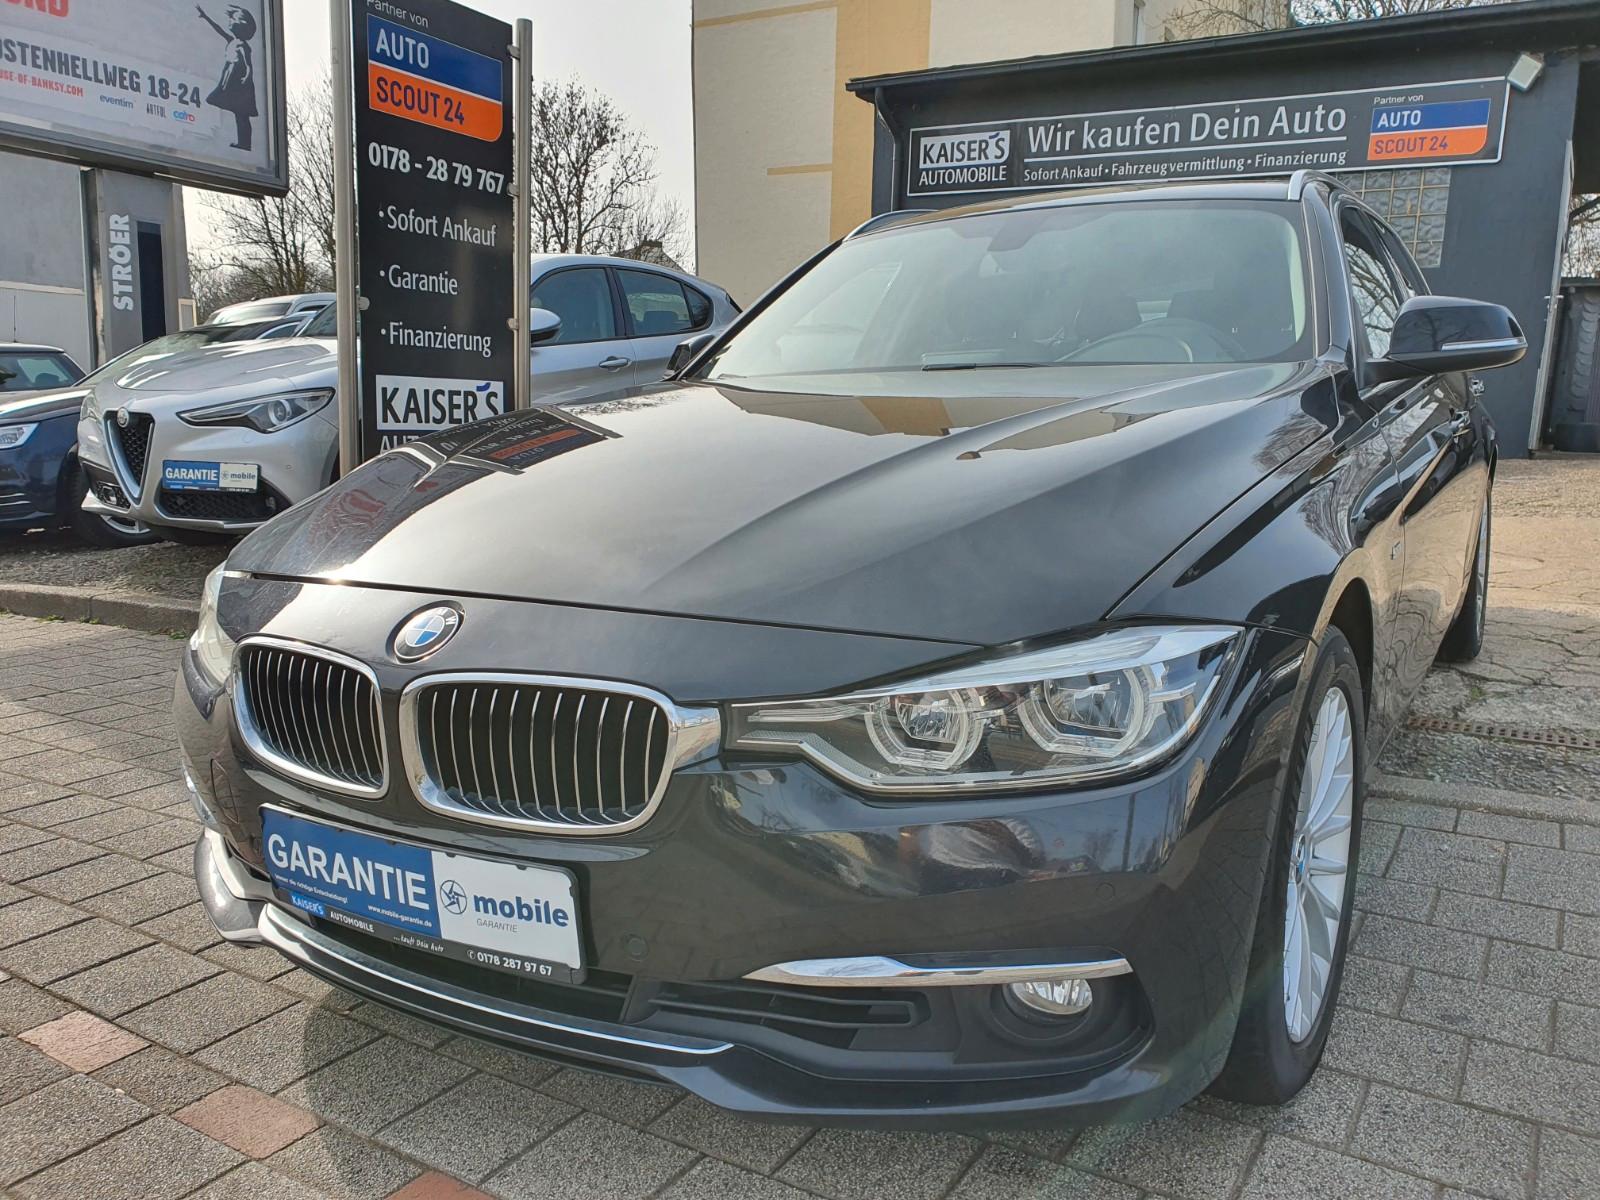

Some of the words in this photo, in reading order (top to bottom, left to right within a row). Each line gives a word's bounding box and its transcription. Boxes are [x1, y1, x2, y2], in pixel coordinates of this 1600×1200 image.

[409, 12, 428, 28] von
[376, 28, 430, 69] AUTO
[0, 38, 141, 94] STENHELLWEG
[147, 74, 201, 108] 18-24
[100, 94, 134, 109] eventim
[1373, 95, 1406, 105] Partner
[1407, 94, 1424, 102] von
[1029, 123, 1076, 153] Wir
[1083, 117, 1180, 150] kaufen
[1190, 108, 1258, 142] Dein
[1268, 104, 1347, 136] Auto
[1377, 110, 1422, 128] AUTO
[368, 142, 410, 173] 0178
[452, 162, 472, 188] 79
[477, 168, 505, 195] 767
[919, 165, 1007, 186] AUTOMOBILE
[1024, 166, 1059, 182] Sofort
[1061, 163, 1102, 180] Ankauf
[1111, 153, 1244, 177] Fahrzeugvermittlung
[1255, 150, 1347, 167] Finanzierung
[387, 205, 438, 238] Sofort
[442, 216, 497, 248] Ankauf
[109, 214, 134, 311] STRÖER
[388, 264, 458, 295] Garantie
[389, 321, 492, 358] Finanzierung
[165, 467, 218, 481] GARANTIE
[230, 472, 256, 480] mobile
[268, 833, 430, 911] GARANTIE
[330, 910, 375, 933] AUTOMOBILE
[473, 894, 569, 927] mobile
[476, 918, 518, 933] GARANTIE
[477, 951, 500, 966] 0178
[503, 956, 521, 970] 287
[524, 961, 537, 973] 97
[540, 964, 552, 976] 67
